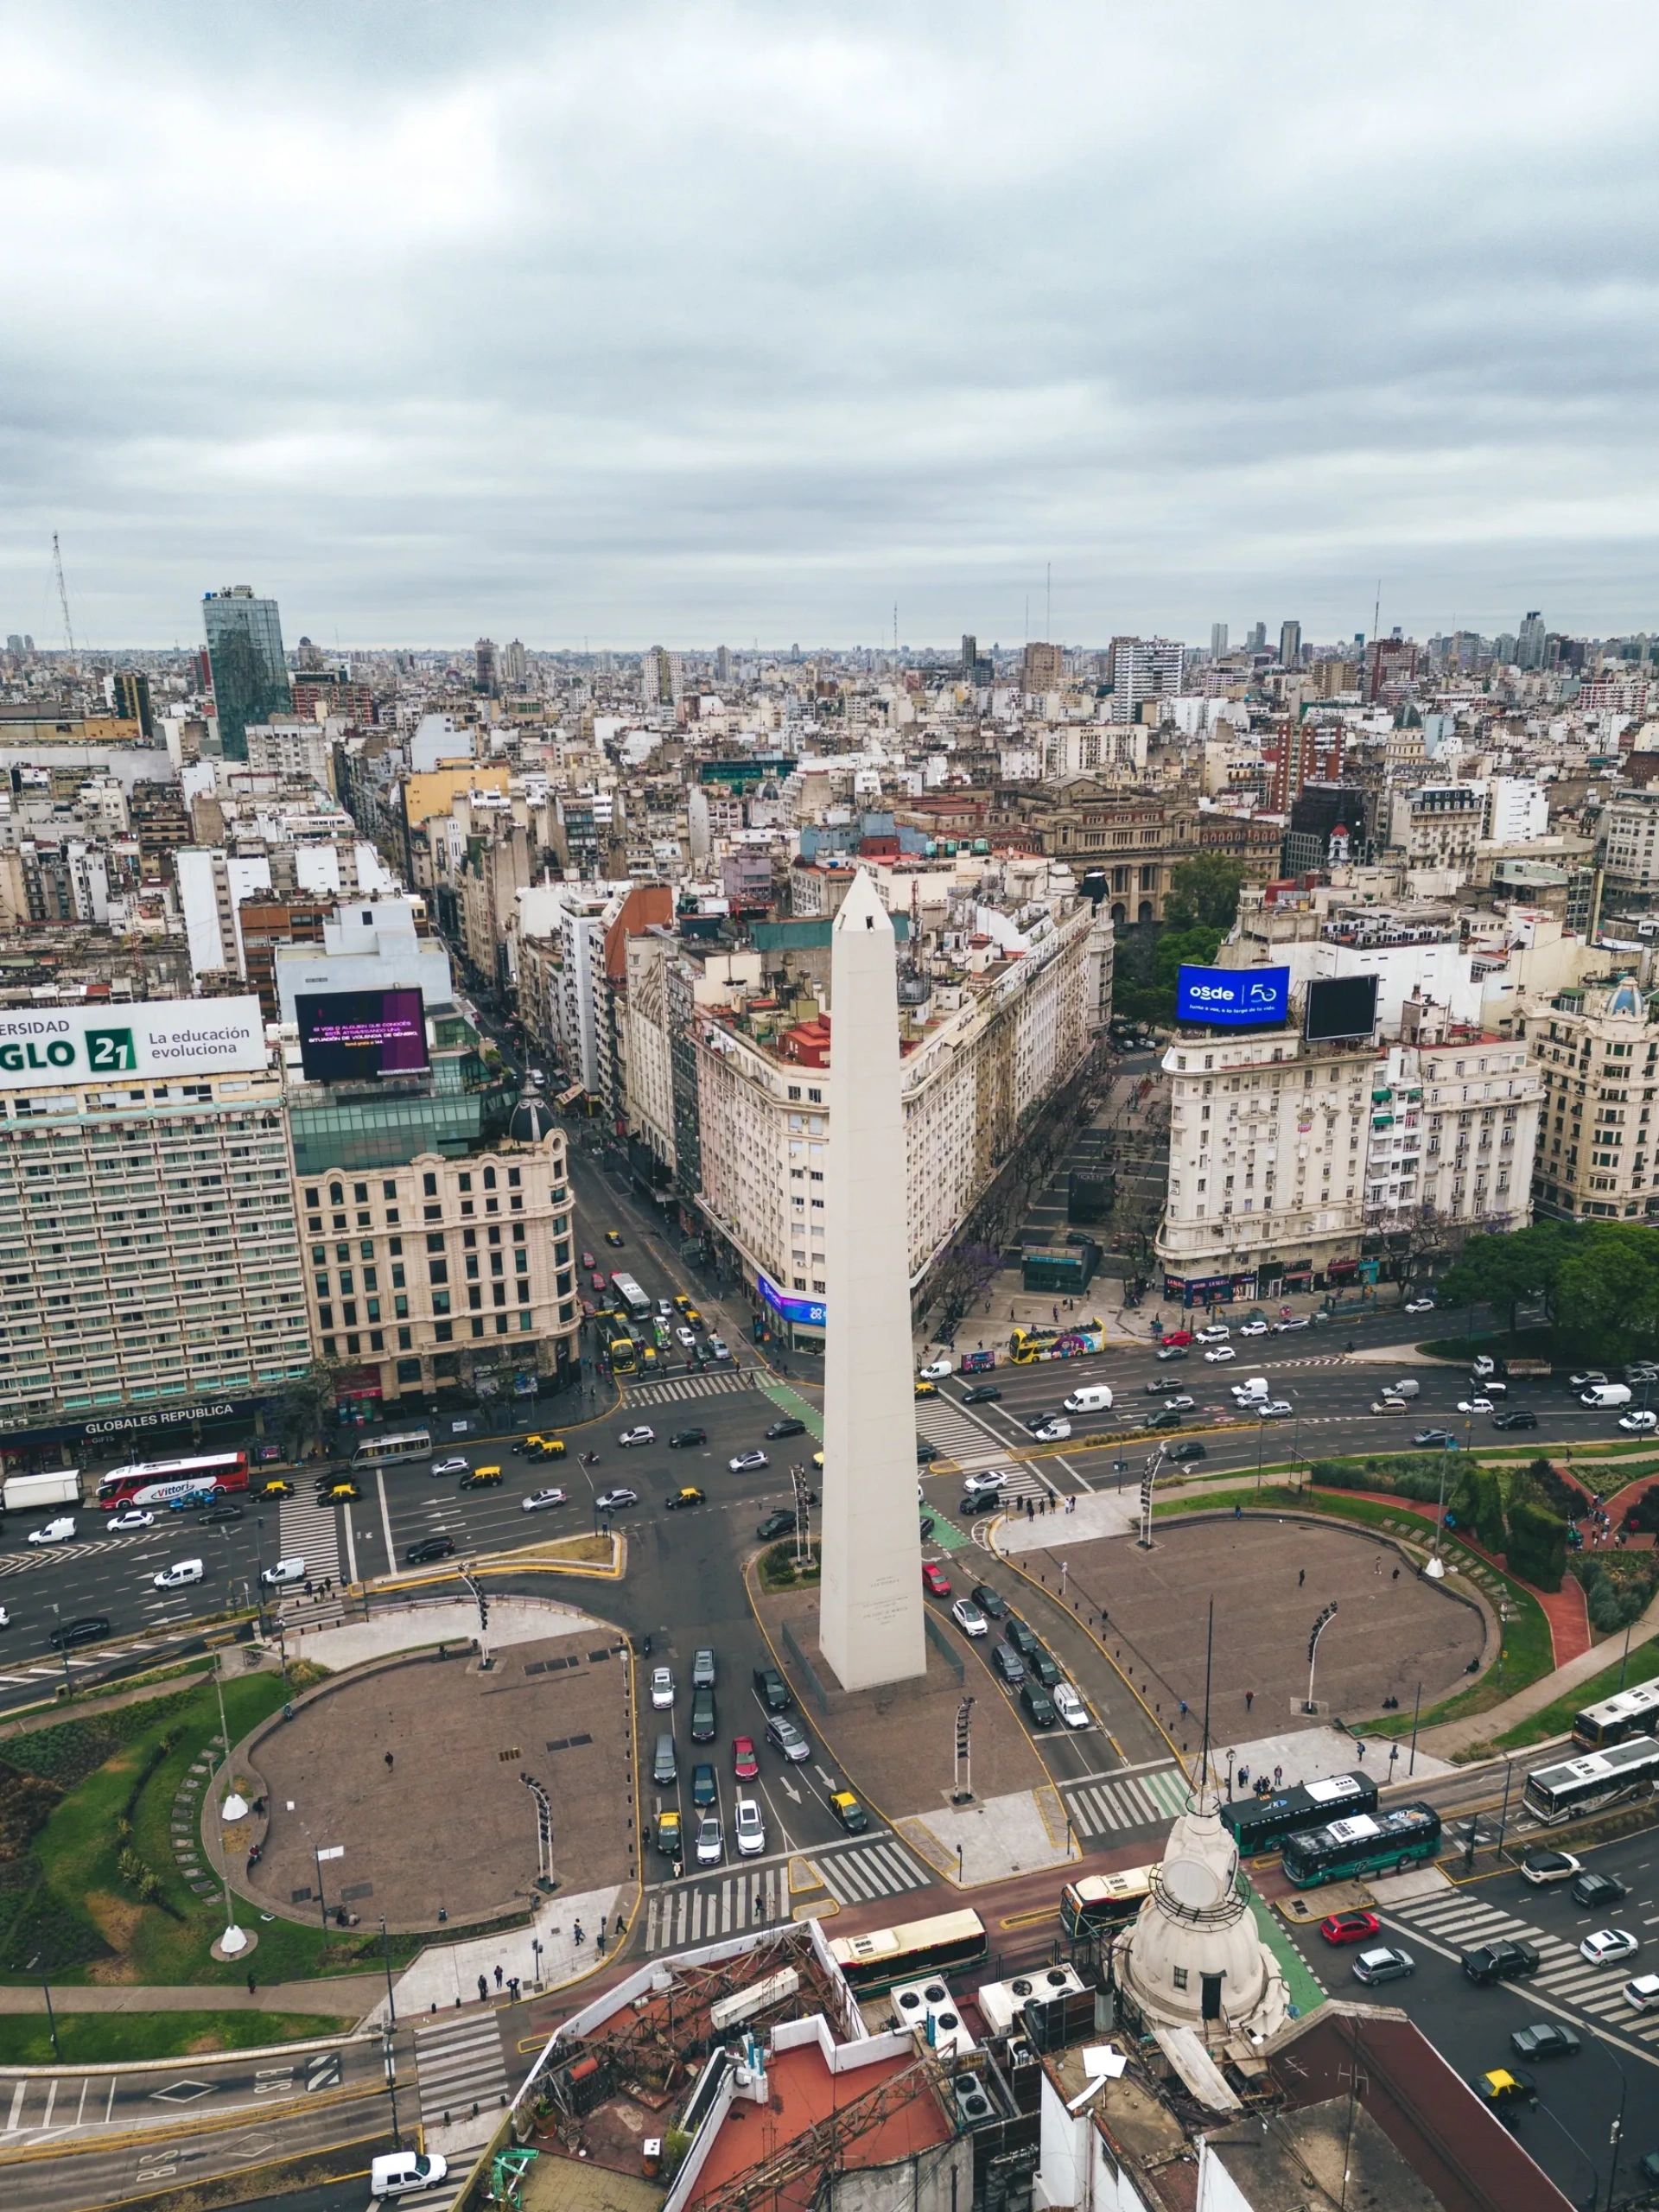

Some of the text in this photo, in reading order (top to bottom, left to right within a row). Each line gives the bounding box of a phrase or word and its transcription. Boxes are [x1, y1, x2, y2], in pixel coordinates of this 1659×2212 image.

[1190, 984, 1277, 1002] osde 50
[0, 1020, 70, 1036] ERSIDAD
[149, 1027, 250, 1045] La educación
[0, 1041, 75, 1071] GLO
[94, 1038, 128, 1070] 21
[151, 1042, 237, 1059] evoluciona
[86, 1404, 233, 1434] GLOBALES REPUBLICA
[157, 1481, 189, 1497] Vittori
